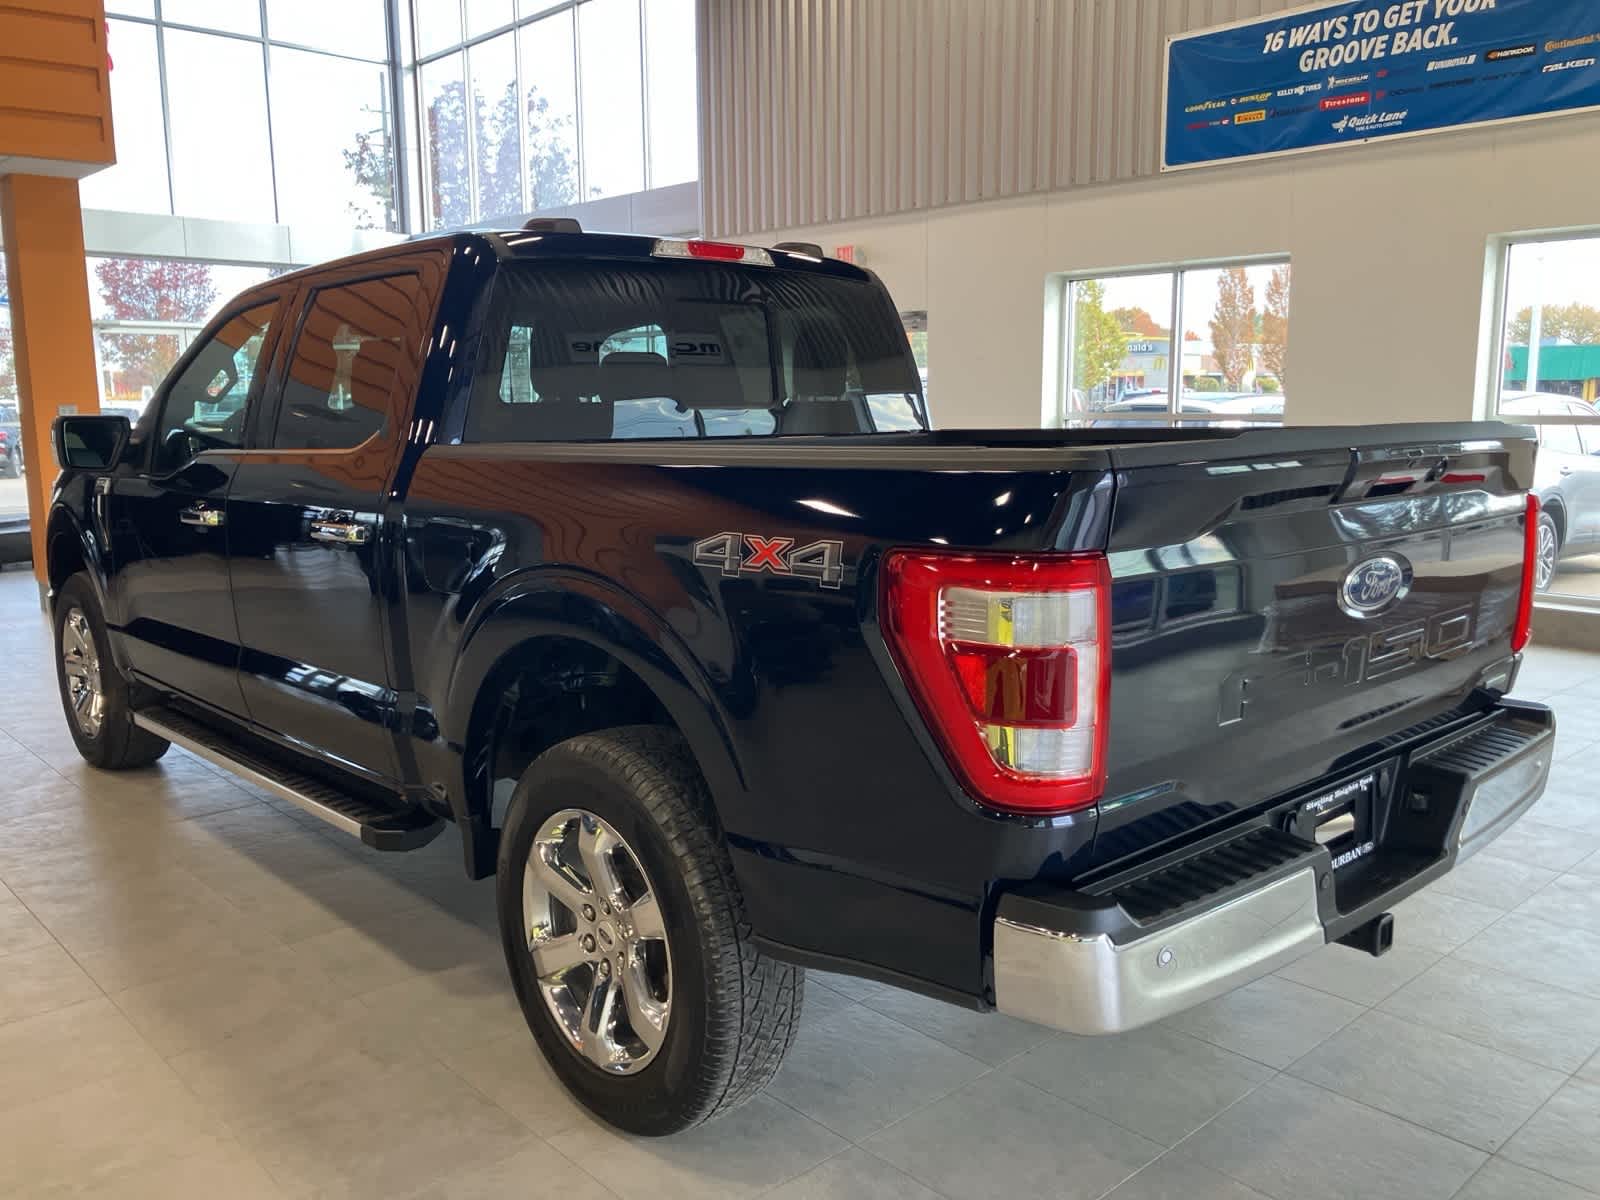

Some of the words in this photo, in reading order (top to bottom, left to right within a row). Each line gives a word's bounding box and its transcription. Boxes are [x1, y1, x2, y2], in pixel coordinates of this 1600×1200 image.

[1263, 30, 1287, 54] 16
[1288, 16, 1349, 49] WAYS
[1352, 9, 1380, 36] TO
[1383, 0, 1430, 29] GET
[1299, 34, 1390, 73] GROOVE
[1391, 21, 1459, 56] BACK.
[1542, 58, 1596, 73] FALKEN
[1324, 96, 1366, 108] Firestone
[1348, 113, 1379, 128] Quick
[1378, 110, 1408, 122] Lane
[1361, 570, 1400, 600] Ford
